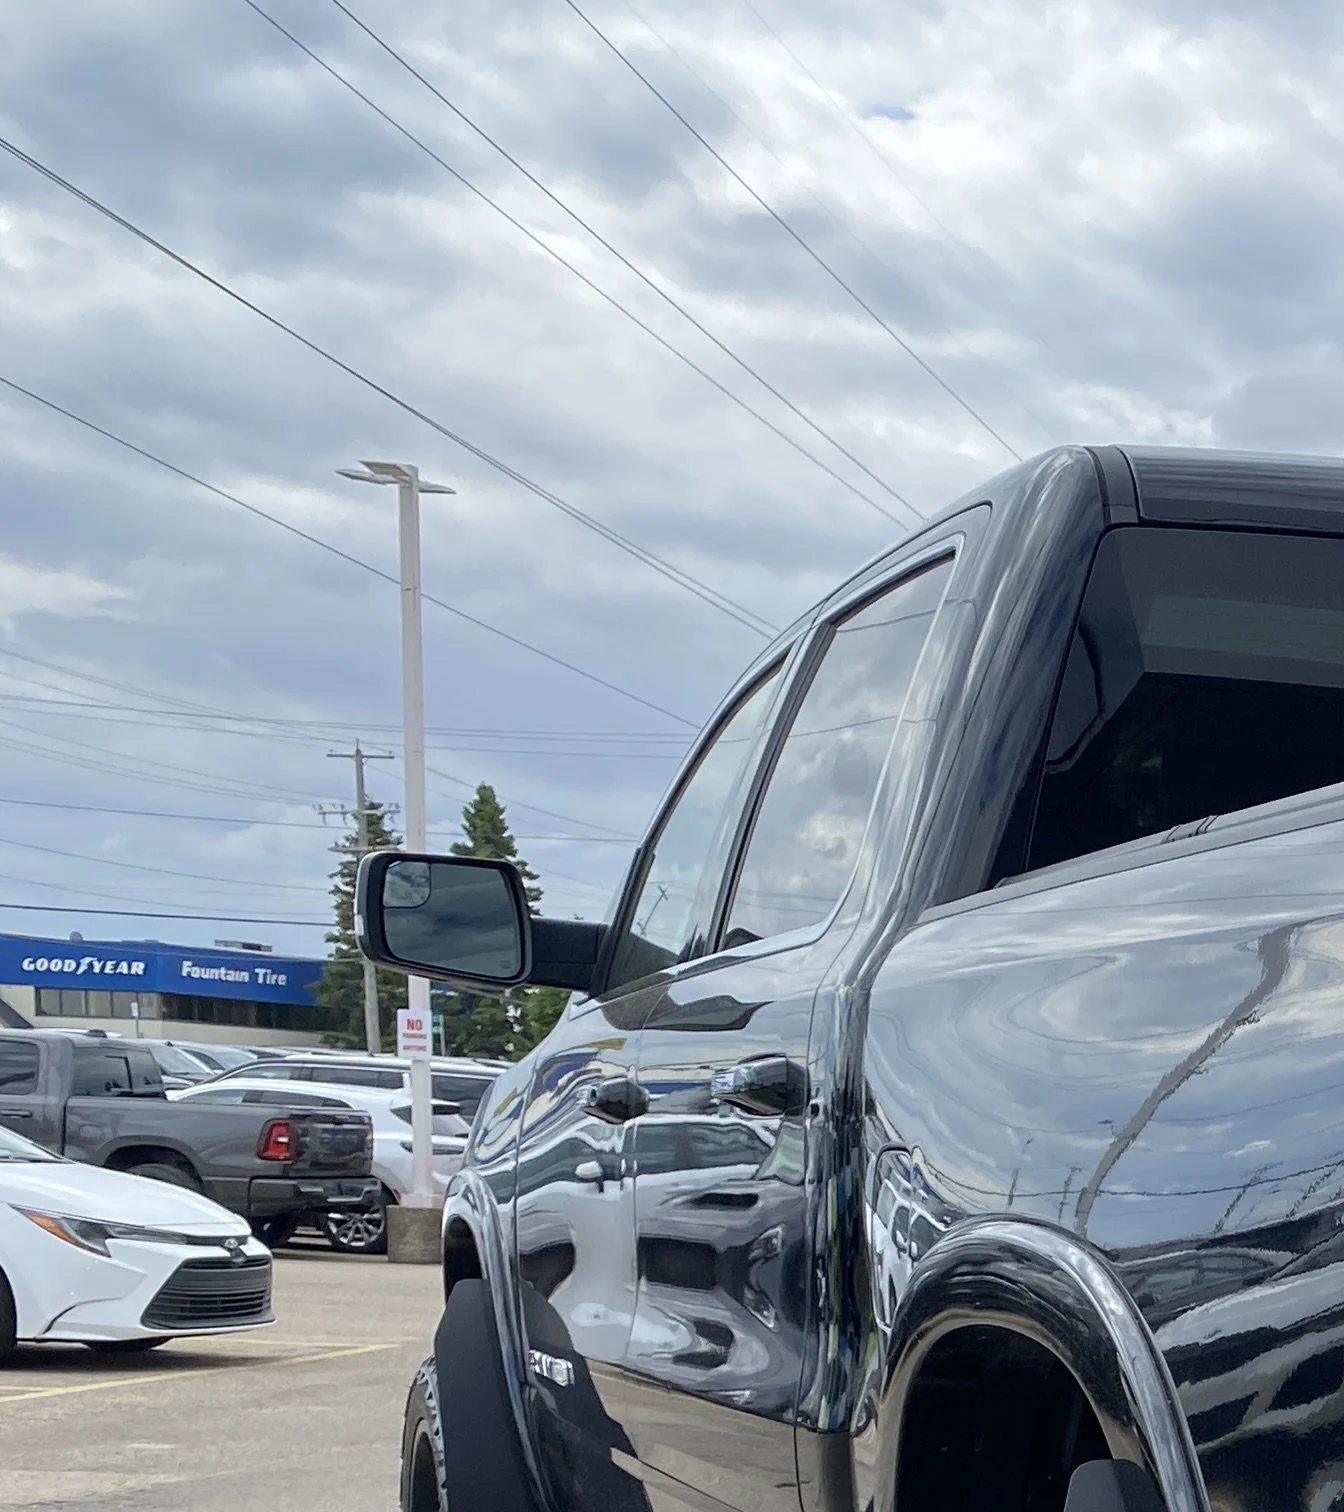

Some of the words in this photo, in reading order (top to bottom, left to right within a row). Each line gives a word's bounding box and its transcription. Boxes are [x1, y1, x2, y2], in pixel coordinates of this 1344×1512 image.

[22, 956, 146, 976] GOODYEAR
[181, 961, 249, 982] Fountain
[254, 968, 287, 985] Tire
[406, 1018, 423, 1031] NO
